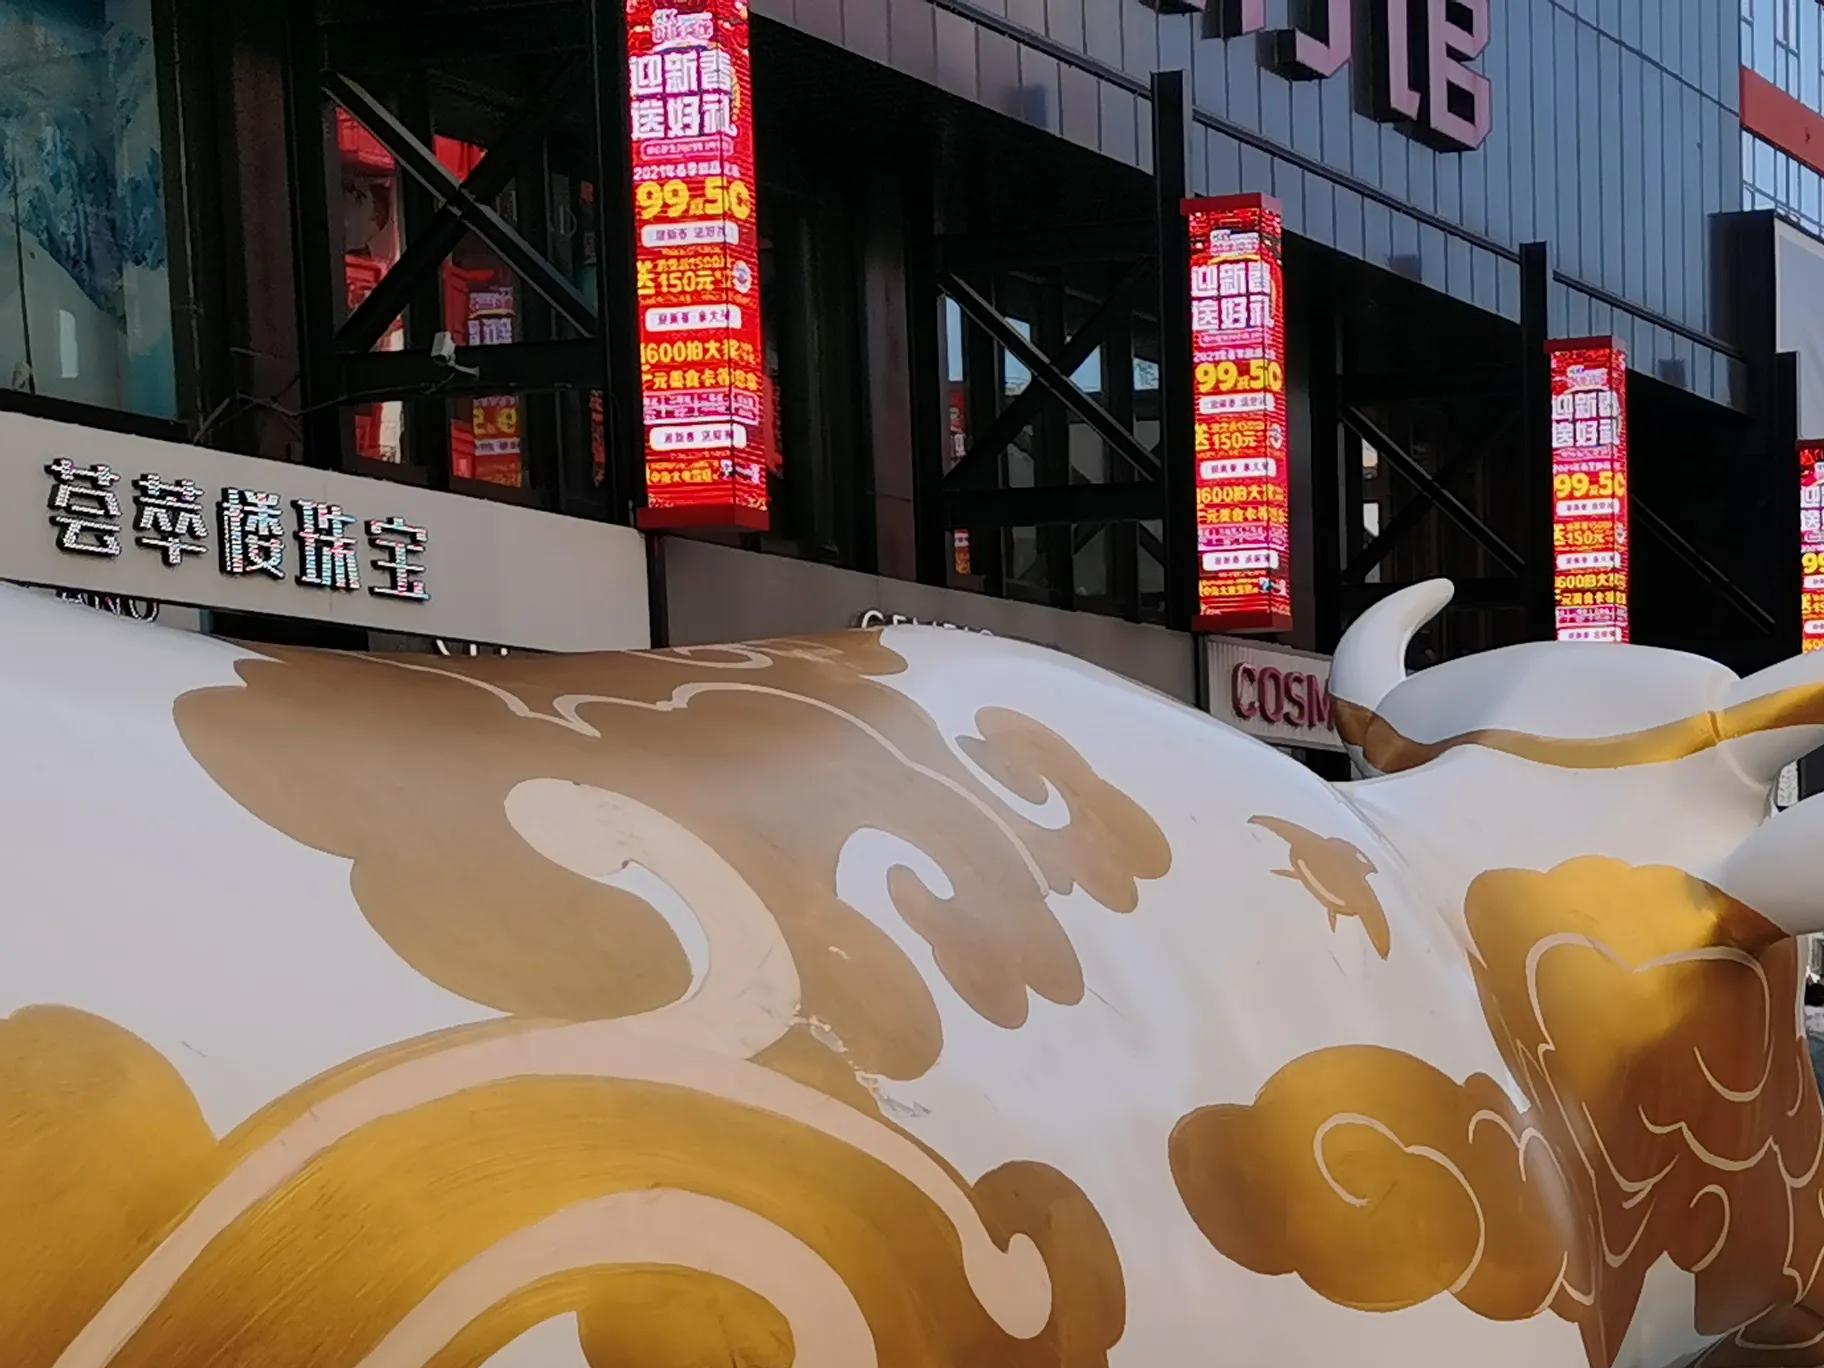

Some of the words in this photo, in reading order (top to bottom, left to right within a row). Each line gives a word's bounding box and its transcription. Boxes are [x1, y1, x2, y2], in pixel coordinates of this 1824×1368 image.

[45, 457, 430, 602] 荟萃楼珠宝
